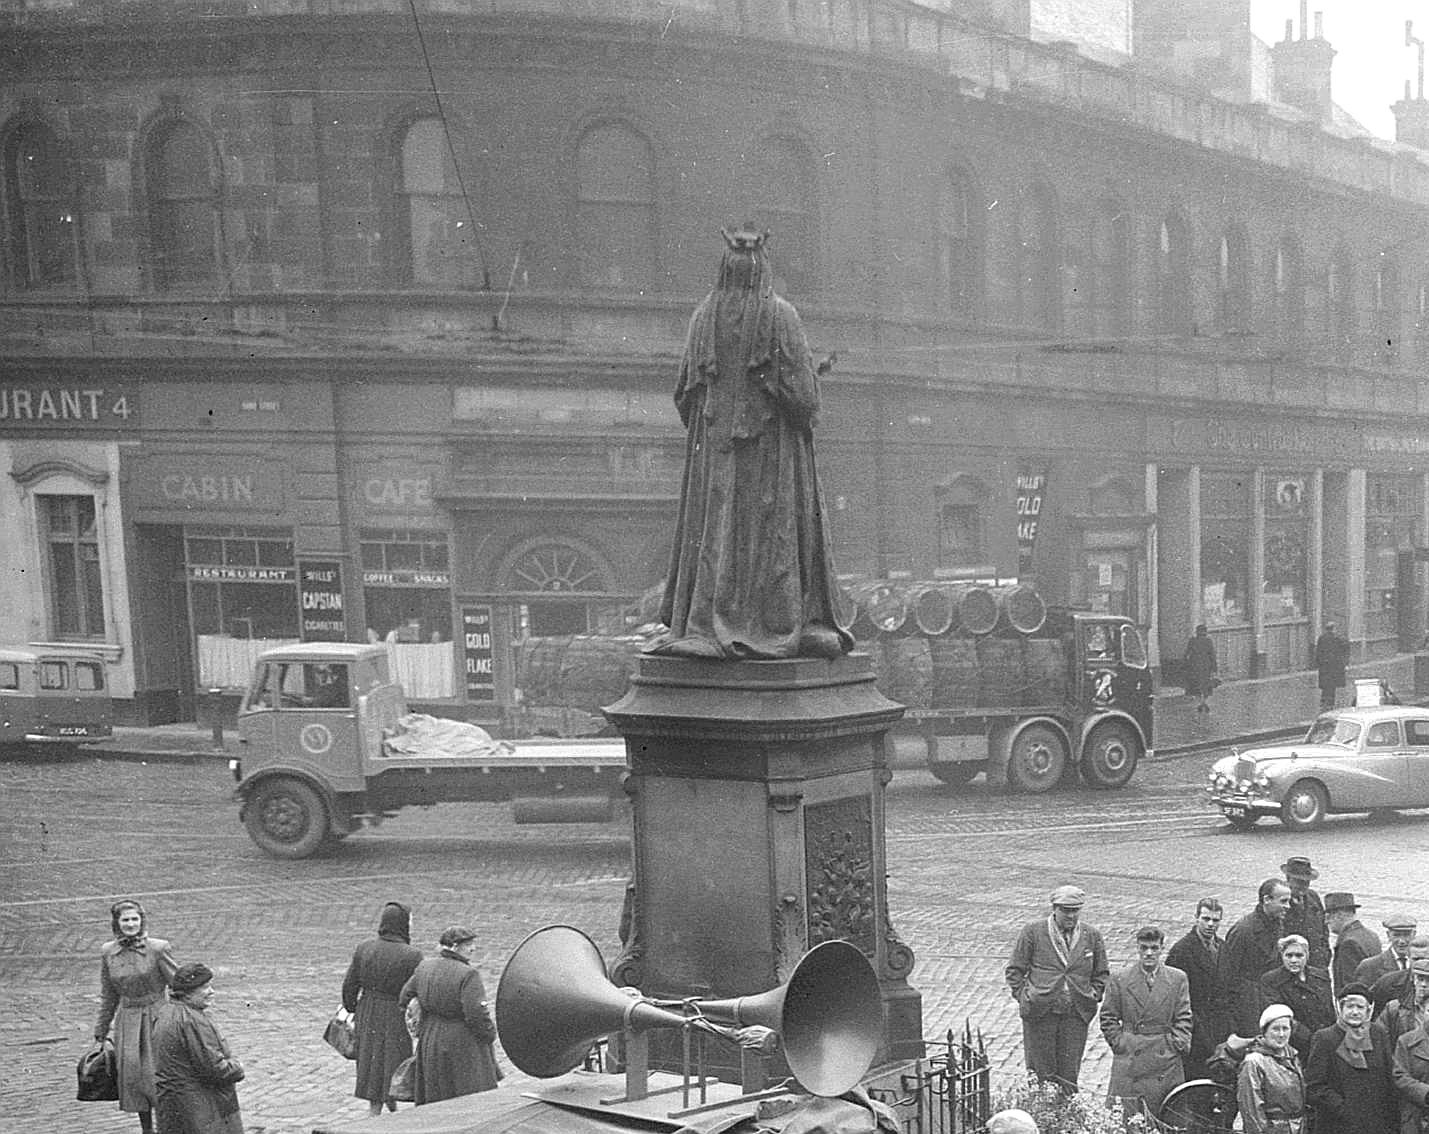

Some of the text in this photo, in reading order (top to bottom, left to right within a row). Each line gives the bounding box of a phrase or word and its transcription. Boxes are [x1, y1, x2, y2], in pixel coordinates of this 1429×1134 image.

[112, 395, 132, 420] 4
[162, 476, 252, 501] CABIN
[365, 478, 431, 505] CAFE
[1016, 497, 1041, 516] OLD
[193, 567, 288, 580] RESTAURANT
[302, 591, 343, 610] CAPSTAN
[465, 632, 490, 649] GOLD
[466, 657, 492, 673] FLAKE
